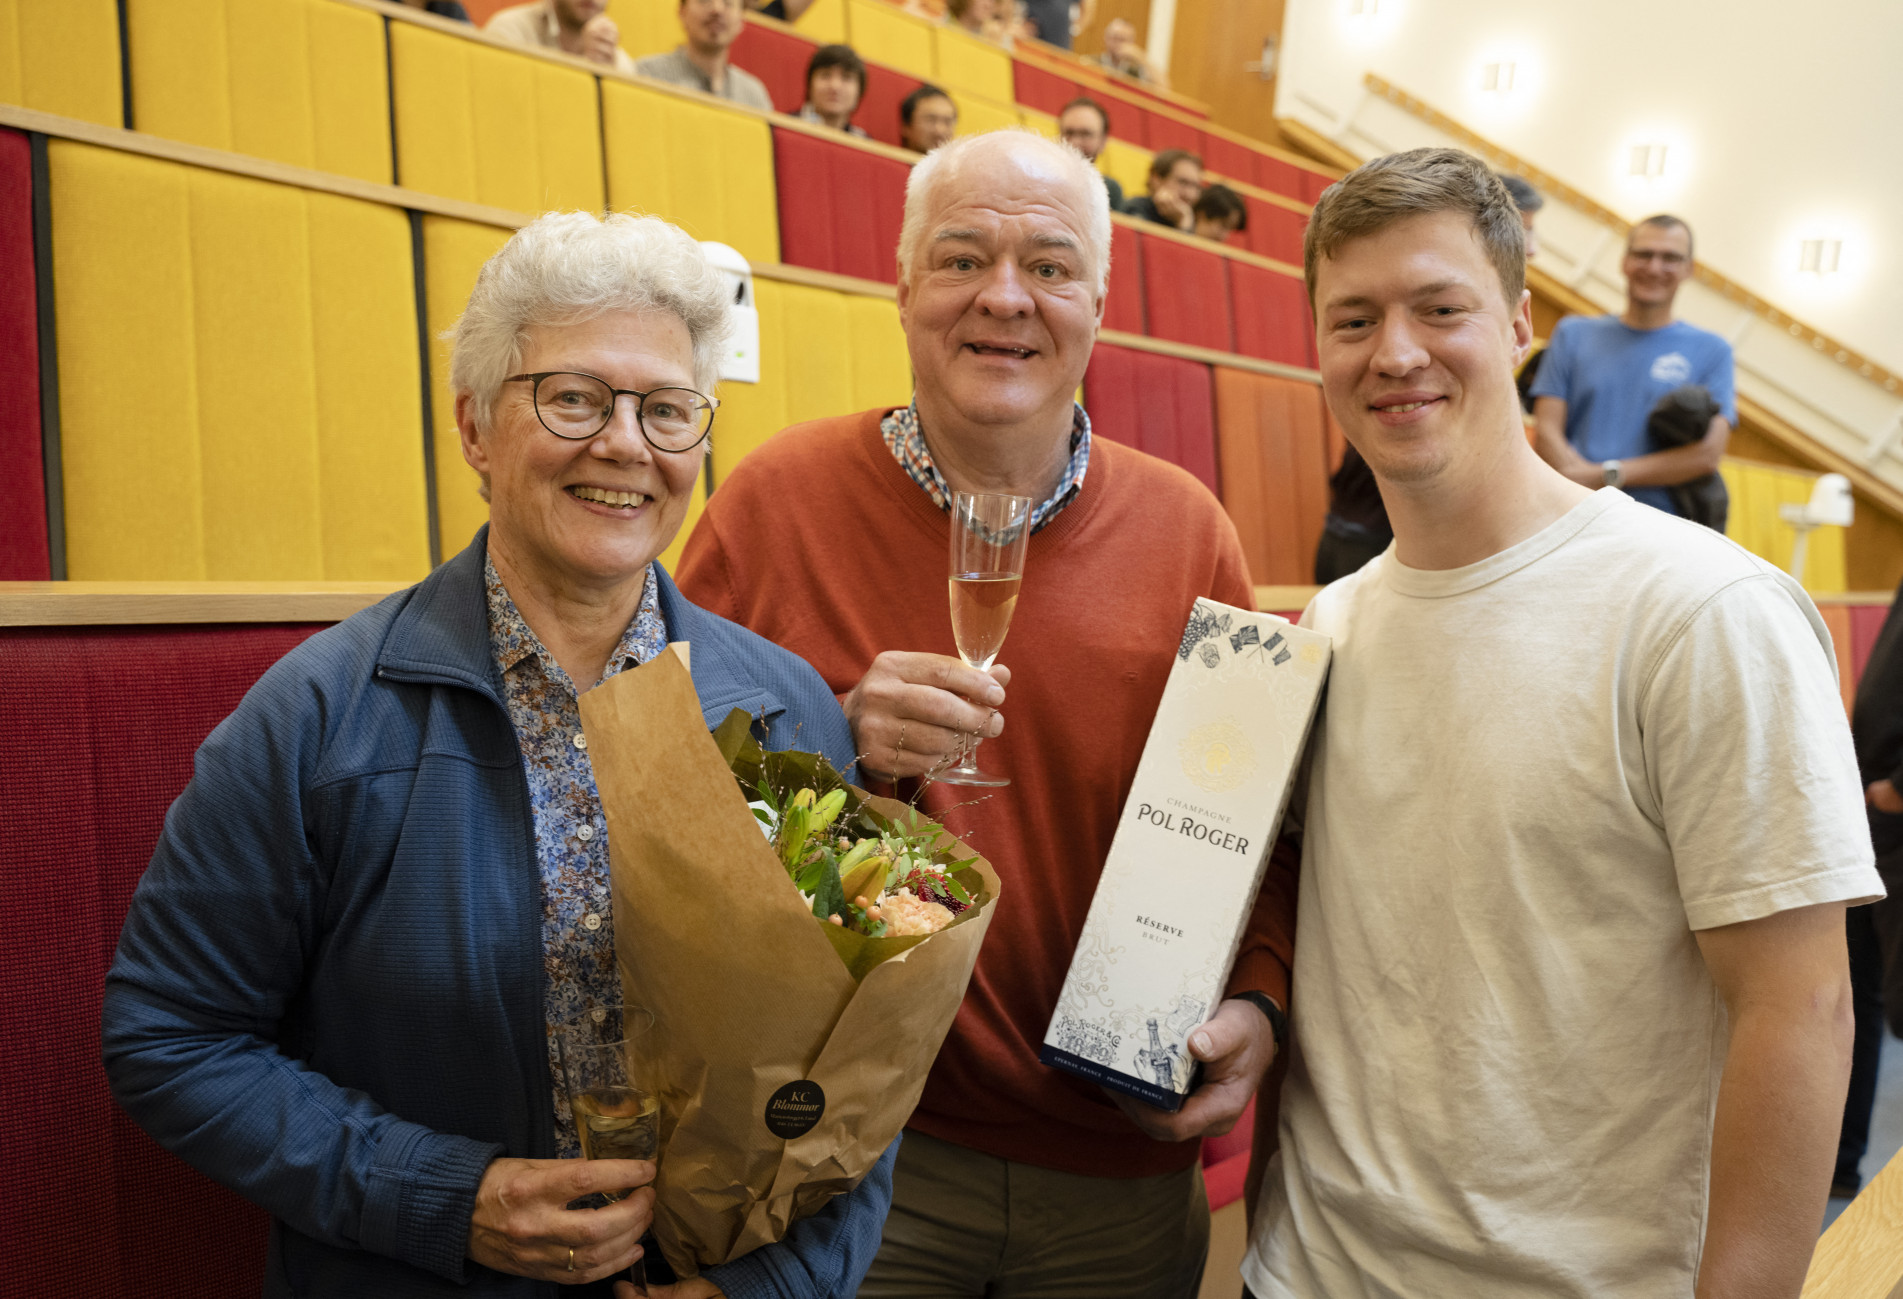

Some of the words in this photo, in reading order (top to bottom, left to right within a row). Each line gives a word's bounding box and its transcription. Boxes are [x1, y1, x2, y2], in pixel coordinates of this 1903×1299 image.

[1166, 797, 1232, 824] CHAMPAGNE
[1137, 803, 1175, 831] POL
[1179, 817, 1249, 855] ROGER
[1136, 915, 1184, 938] RÉSERVE
[1142, 931, 1170, 945] BRUT
[772, 1099, 820, 1112] Blommor
[791, 1091, 810, 1102] KC
